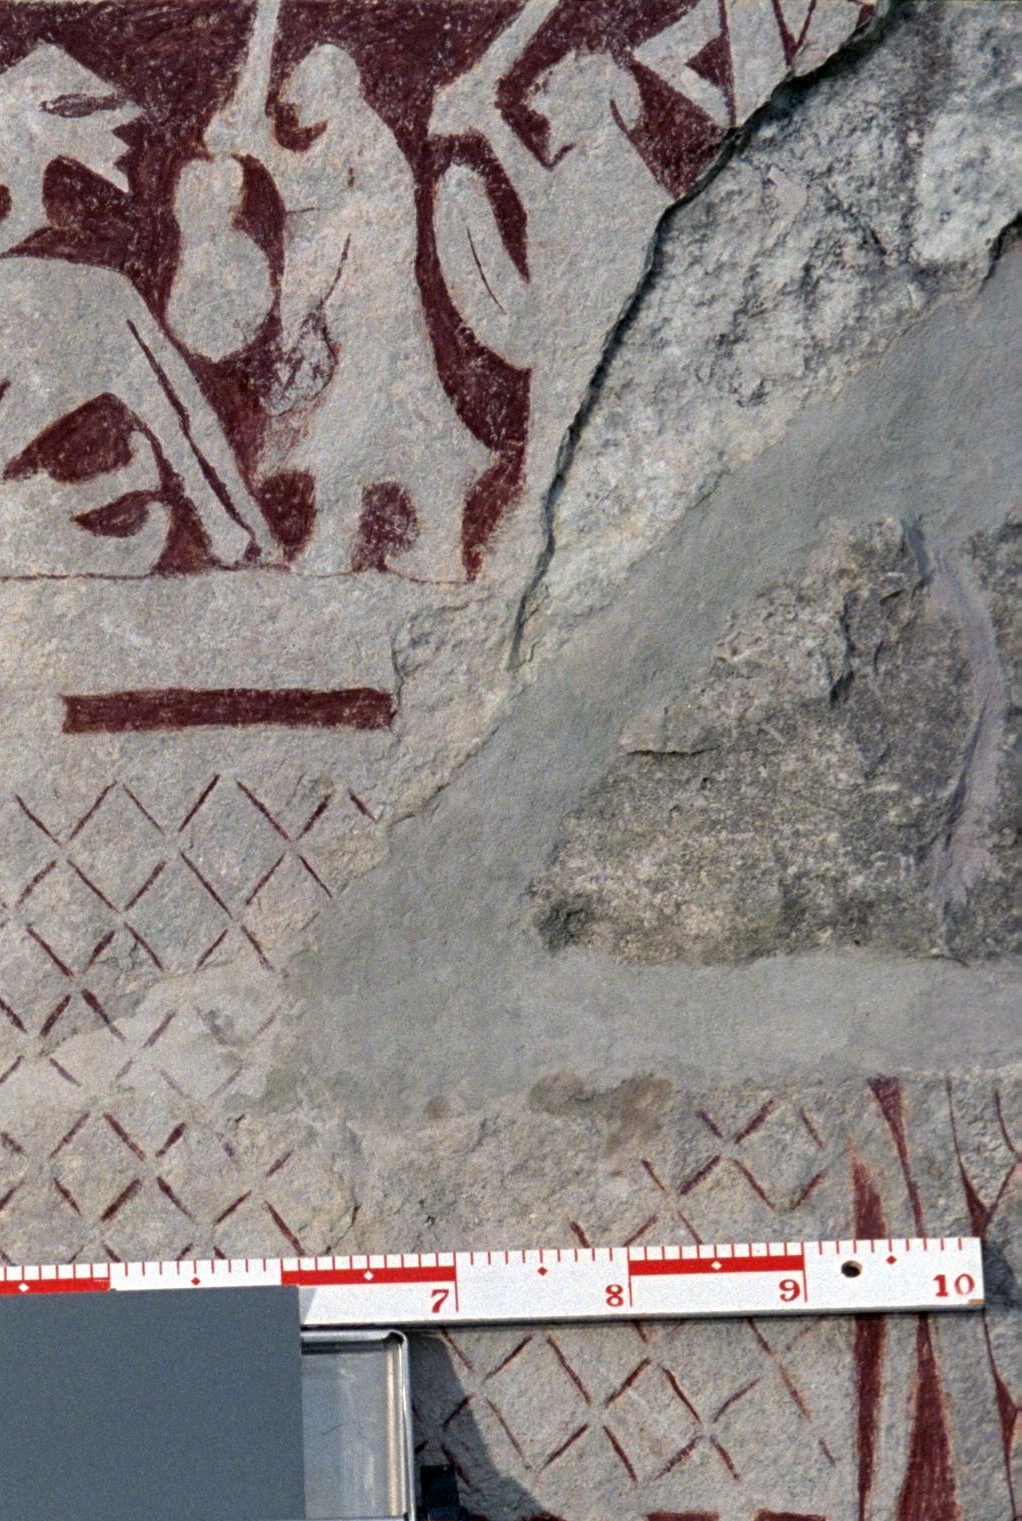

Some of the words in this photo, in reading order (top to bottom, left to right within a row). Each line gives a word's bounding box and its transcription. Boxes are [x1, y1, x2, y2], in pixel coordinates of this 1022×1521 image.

[430, 1289, 450, 1313] 7
[605, 1284, 624, 1307] 8
[778, 1279, 801, 1302] 9
[932, 1273, 976, 1298] 10
